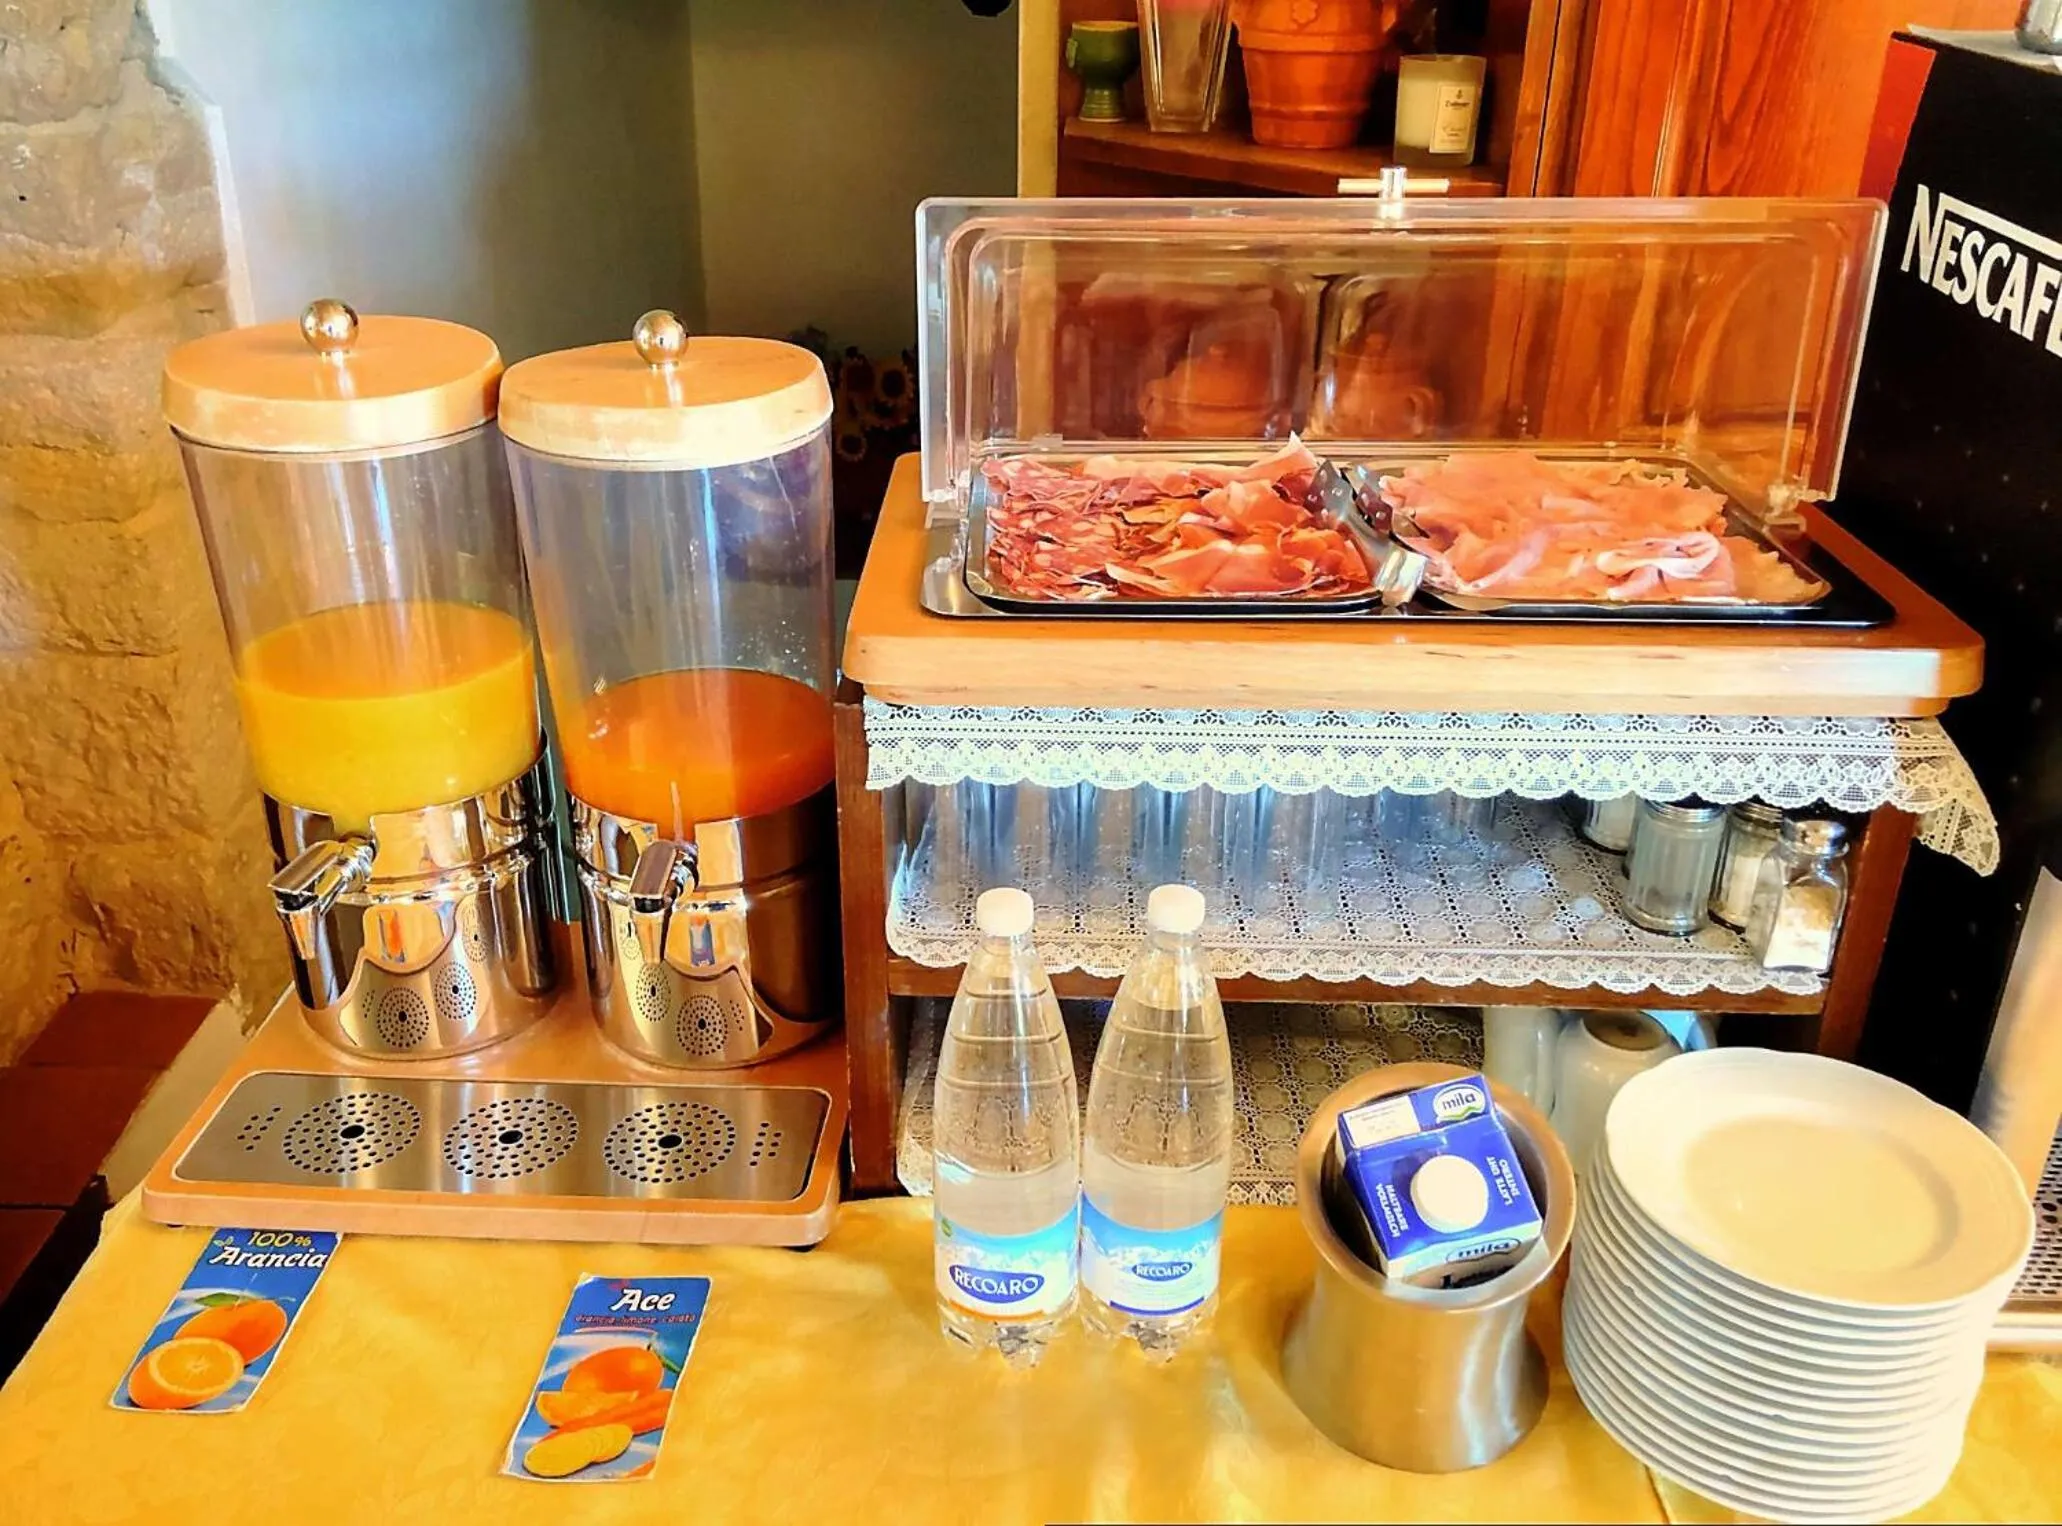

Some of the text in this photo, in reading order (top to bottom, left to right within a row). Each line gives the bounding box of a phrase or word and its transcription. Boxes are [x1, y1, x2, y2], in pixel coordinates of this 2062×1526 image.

[1442, 1091, 1477, 1110] mila
[247, 1231, 312, 1248] 100%
[209, 1246, 328, 1268] Arancia
[1458, 1242, 1511, 1258] mila
[1135, 1263, 1190, 1278] RECOARO
[953, 1267, 1039, 1296] RECOARO
[610, 1288, 677, 1312] Ace
